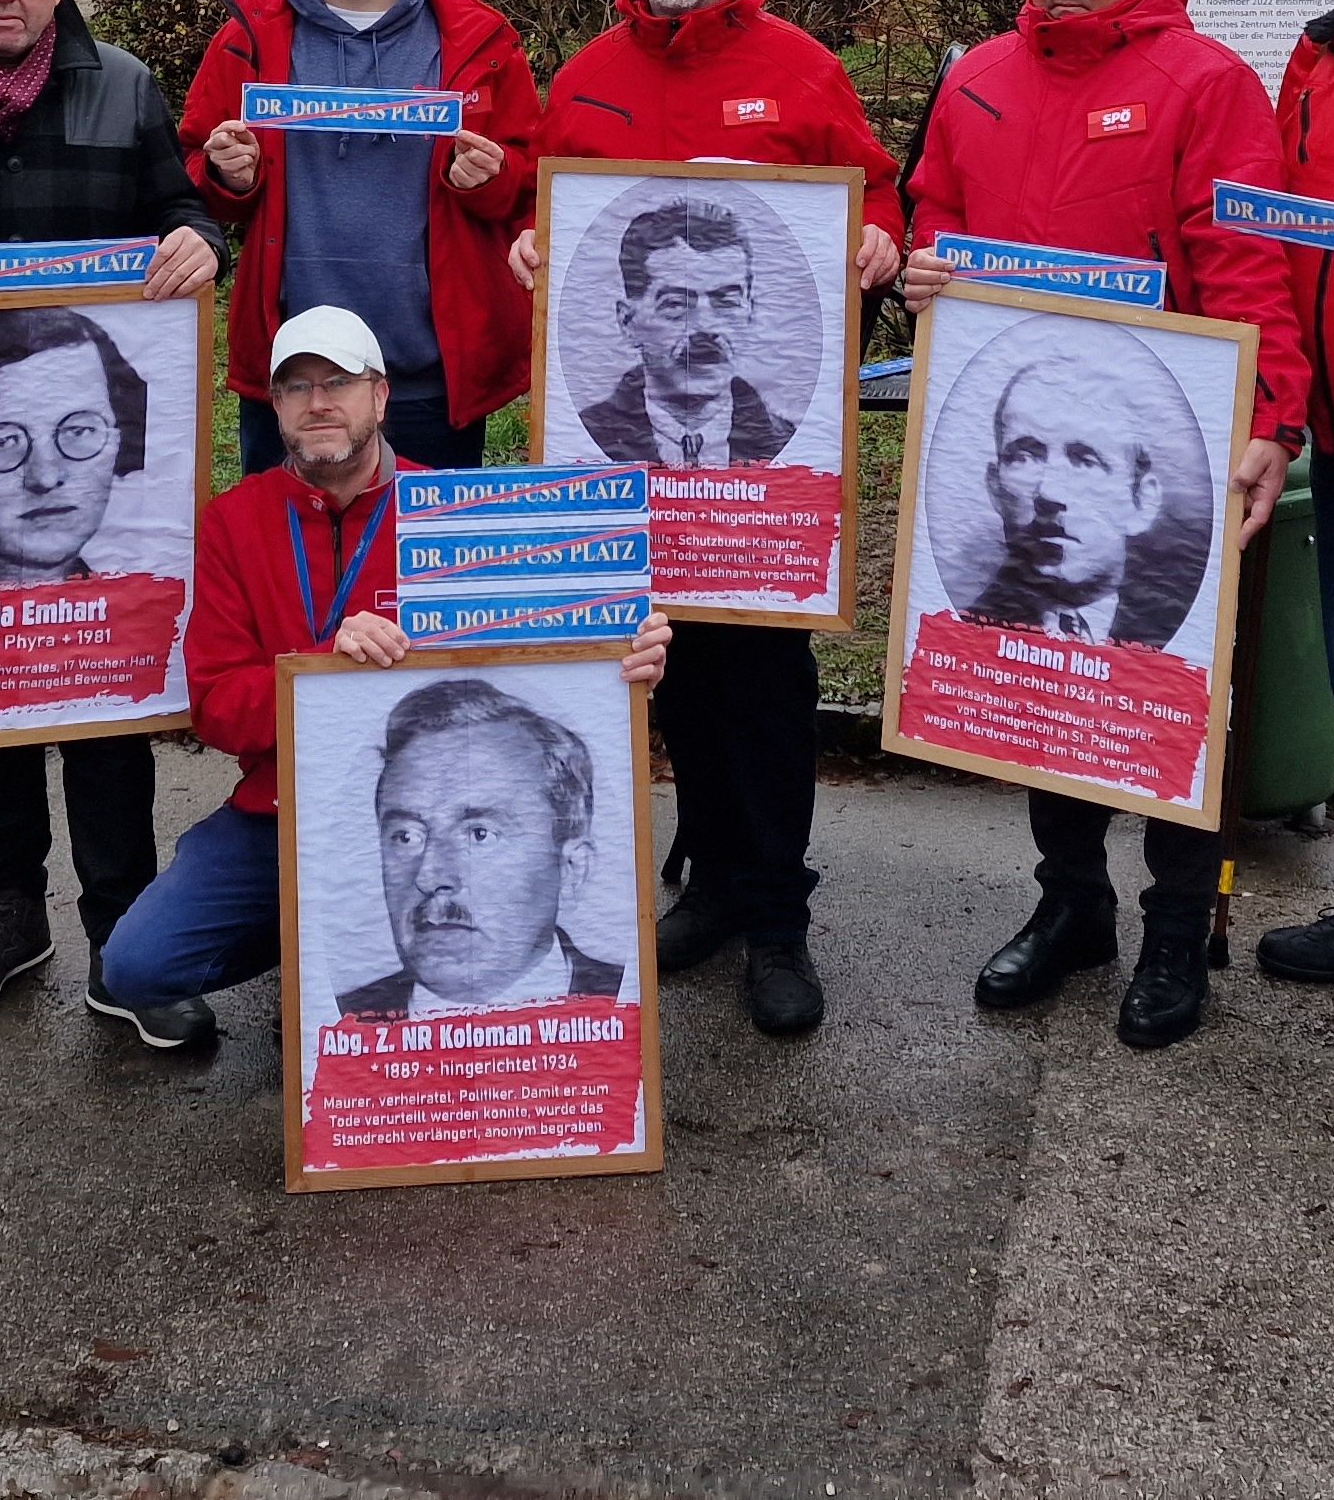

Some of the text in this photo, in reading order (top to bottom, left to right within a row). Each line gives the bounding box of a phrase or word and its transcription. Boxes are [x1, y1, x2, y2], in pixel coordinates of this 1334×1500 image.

[256, 98, 450, 123] DR. DOLLFUSS PLATZ
[737, 100, 765, 115] SPÖ
[1101, 108, 1131, 126] SPÖ
[1226, 198, 1259, 222] DR.
[81, 252, 145, 273] PLATZ
[946, 248, 1151, 294] DR. DOLLFUSS PLATZ
[410, 479, 635, 507] DR. DOLLFUSS PLATZ
[651, 477, 766, 501] Münichreiter
[649, 508, 695, 521] kirchen
[711, 510, 787, 526] hingerichtet
[791, 512, 819, 526] 1934
[411, 541, 635, 568] DR. DOLLFUSS PLATZ
[679, 535, 804, 552] Schutzbund-Kämpfer,
[671, 549, 698, 561] Tode
[763, 551, 781, 564] auf
[784, 554, 819, 566] Bahre
[650, 564, 818, 585] tragen, Leichnam verscharrt.
[22, 597, 106, 625] Emhart
[411, 604, 638, 632] DR. DOLLFUSS PLATZ
[5, 634, 55, 651] Phyra
[77, 628, 110, 644] 1981
[64, 660, 75, 671] 17
[79, 658, 125, 669] Wochen
[130, 655, 156, 667] Haft,
[998, 635, 1110, 680] Johann Hois
[930, 652, 956, 670] 1891
[973, 662, 1058, 694] hingerichtet
[1064, 684, 1095, 703] 1934
[1101, 691, 1112, 707] in
[1116, 696, 1137, 713] St.
[1143, 701, 1191, 725] Pölten
[932, 680, 1155, 743] Fabriksarbeiter, Schutzbund-Kämpfer,
[957, 704, 1129, 754] von Standgericht in St. Pölten
[924, 714, 1162, 779] wegen Mordversuch zum Tode verurteilt.
[323, 1016, 623, 1056] Abg. Z. NR Koloman Wallisch
[384, 1062, 419, 1078] 1889
[441, 1057, 536, 1078] hingerichtet
[542, 1054, 577, 1070] 1934
[324, 1097, 374, 1109] Maurer,
[460, 1088, 516, 1102] Politiker.
[522, 1085, 559, 1099] Damit
[564, 1086, 577, 1096] er
[582, 1085, 608, 1095] zum
[329, 1101, 603, 1128] Tode verurteilt werden konnte, wurde das
[333, 1130, 404, 1146] Standrecht
[485, 1125, 536, 1139] anonym
[541, 1120, 605, 1136] begraben.
